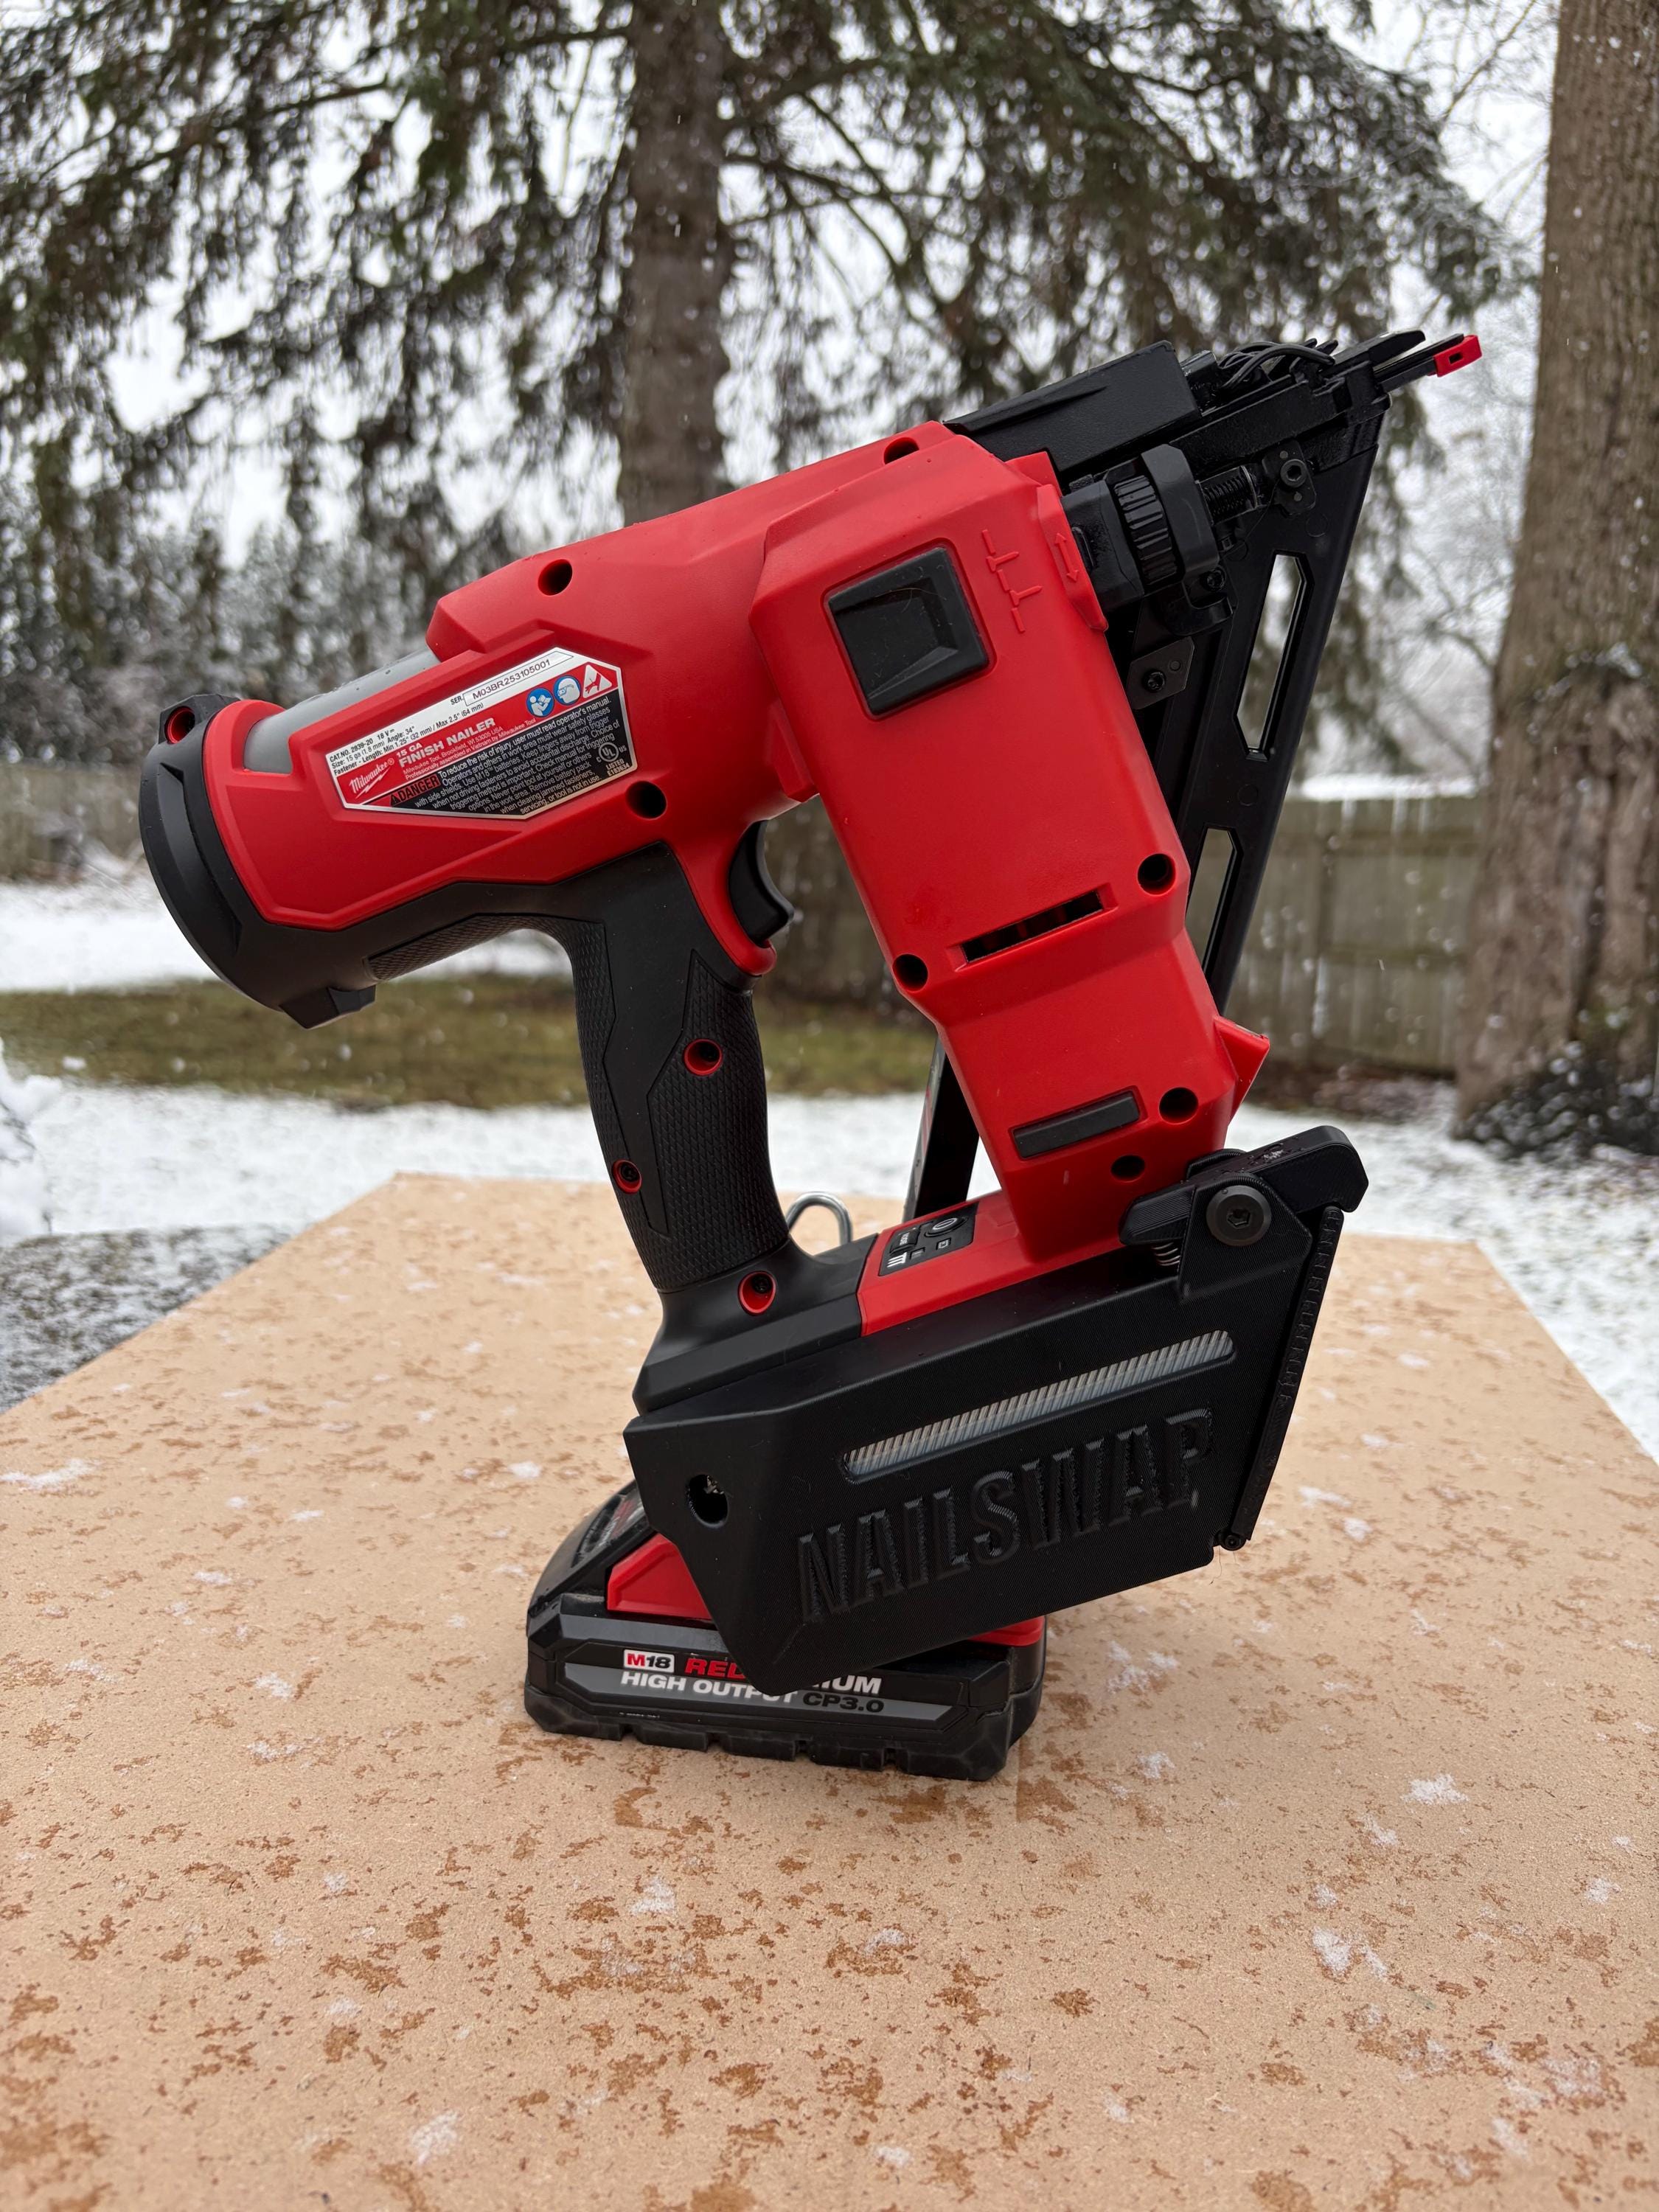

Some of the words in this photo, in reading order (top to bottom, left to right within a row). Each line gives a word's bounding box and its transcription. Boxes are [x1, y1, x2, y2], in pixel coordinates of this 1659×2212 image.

[451, 695, 464, 705] SER.
[472, 659, 551, 700] M03BR253105001
[330, 749, 350, 762] CAT.NO.
[351, 738, 374, 753] 2839-20
[331, 759, 345, 769] Size:
[354, 752, 361, 760] ga
[361, 746, 372, 756] (1.8
[372, 740, 385, 750] mm)
[386, 731, 405, 744] Angle:
[405, 726, 415, 734] 34°
[334, 761, 357, 776] Fastener
[362, 749, 383, 763] Length:
[383, 744, 394, 753] Min
[410, 732, 420, 740] (32
[420, 726, 432, 736] mm)
[436, 719, 448, 728] Max
[461, 709, 470, 717] (64
[471, 703, 484, 712] mm)
[396, 749, 407, 758] 15
[408, 742, 422, 751] GA
[399, 741, 444, 768] FINISH
[446, 717, 495, 745] NAILER
[403, 759, 429, 775] Milwaukee
[491, 726, 503, 735] USA
[406, 762, 439, 781] Professionally
[439, 750, 465, 765] assembled
[471, 738, 491, 751] Vietnam
[498, 723, 525, 738] Milwaukee
[525, 717, 536, 726] Tool
[414, 797, 428, 808] with
[427, 791, 441, 802] side
[440, 781, 463, 797] shields.
[462, 776, 476, 787] Use
[521, 747, 539, 761] Keep
[538, 738, 560, 754] fingers
[559, 732, 576, 745] away
[575, 724, 589, 736] from
[588, 715, 611, 731] trigger
[438, 770, 447, 779] To
[446, 760, 467, 776] reduce
[467, 756, 478, 766] the
[477, 751, 489, 762] risk
[488, 748, 495, 757] of
[495, 740, 514, 755] injury,
[512, 735, 527, 745] user
[526, 727, 543, 740] must
[541, 720, 556, 732] read
[585, 695, 611, 712] manual.
[442, 768, 473, 787] Operators
[471, 763, 484, 773] and
[483, 754, 502, 768] others
[501, 751, 508, 760] in
[507, 745, 524, 757] work
[523, 740, 538, 751] area
[537, 732, 552, 744] must
[552, 726, 568, 737] wear
[567, 716, 587, 731] safety
[585, 706, 611, 723] glasses
[397, 775, 439, 801] DANGER
[432, 796, 451, 809] when
[449, 792, 460, 801] not
[459, 783, 480, 799] driving
[479, 771, 507, 789] fasteners
[506, 768, 513, 776] to
[512, 760, 530, 773] avoid
[529, 746, 560, 766] accidental
[559, 732, 592, 754] discharge.
[591, 723, 613, 738] Choice
[613, 720, 620, 728] of
[450, 793, 479, 812] triggering
[478, 782, 501, 798] method
[500, 780, 507, 788] is
[506, 767, 537, 787] important.
[535, 758, 556, 772] Check
[554, 748, 577, 763] manual
[577, 744, 587, 754] for
[585, 731, 615, 751] triggering
[490, 801, 501, 810] the
[499, 794, 515, 806] work
[514, 788, 529, 799] area.
[529, 776, 555, 793] Remove
[554, 767, 577, 782] battery
[575, 760, 591, 773] pack
[491, 787, 510, 801] Never
[509, 781, 526, 793] point
[524, 776, 536, 786] tool
[542, 762, 567, 779] yourself
[572, 751, 592, 765] others
[606, 759, 625, 771] LISTED
[501, 801, 518, 815] when
[517, 791, 541, 808] clearing
[540, 781, 565, 798] jammed
[564, 767, 595, 787] fasteners,
[520, 797, 549, 815] servicing,
[554, 789, 567, 799] tool
[566, 786, 573, 794] is
[572, 782, 583, 791] not
[588, 773, 602, 784] use.
[799, 1408, 1214, 1620] NAILSWAP
[627, 1653, 671, 1669] M18
[621, 1671, 686, 1691] HIGH
[803, 1692, 884, 1713] CP3.0
